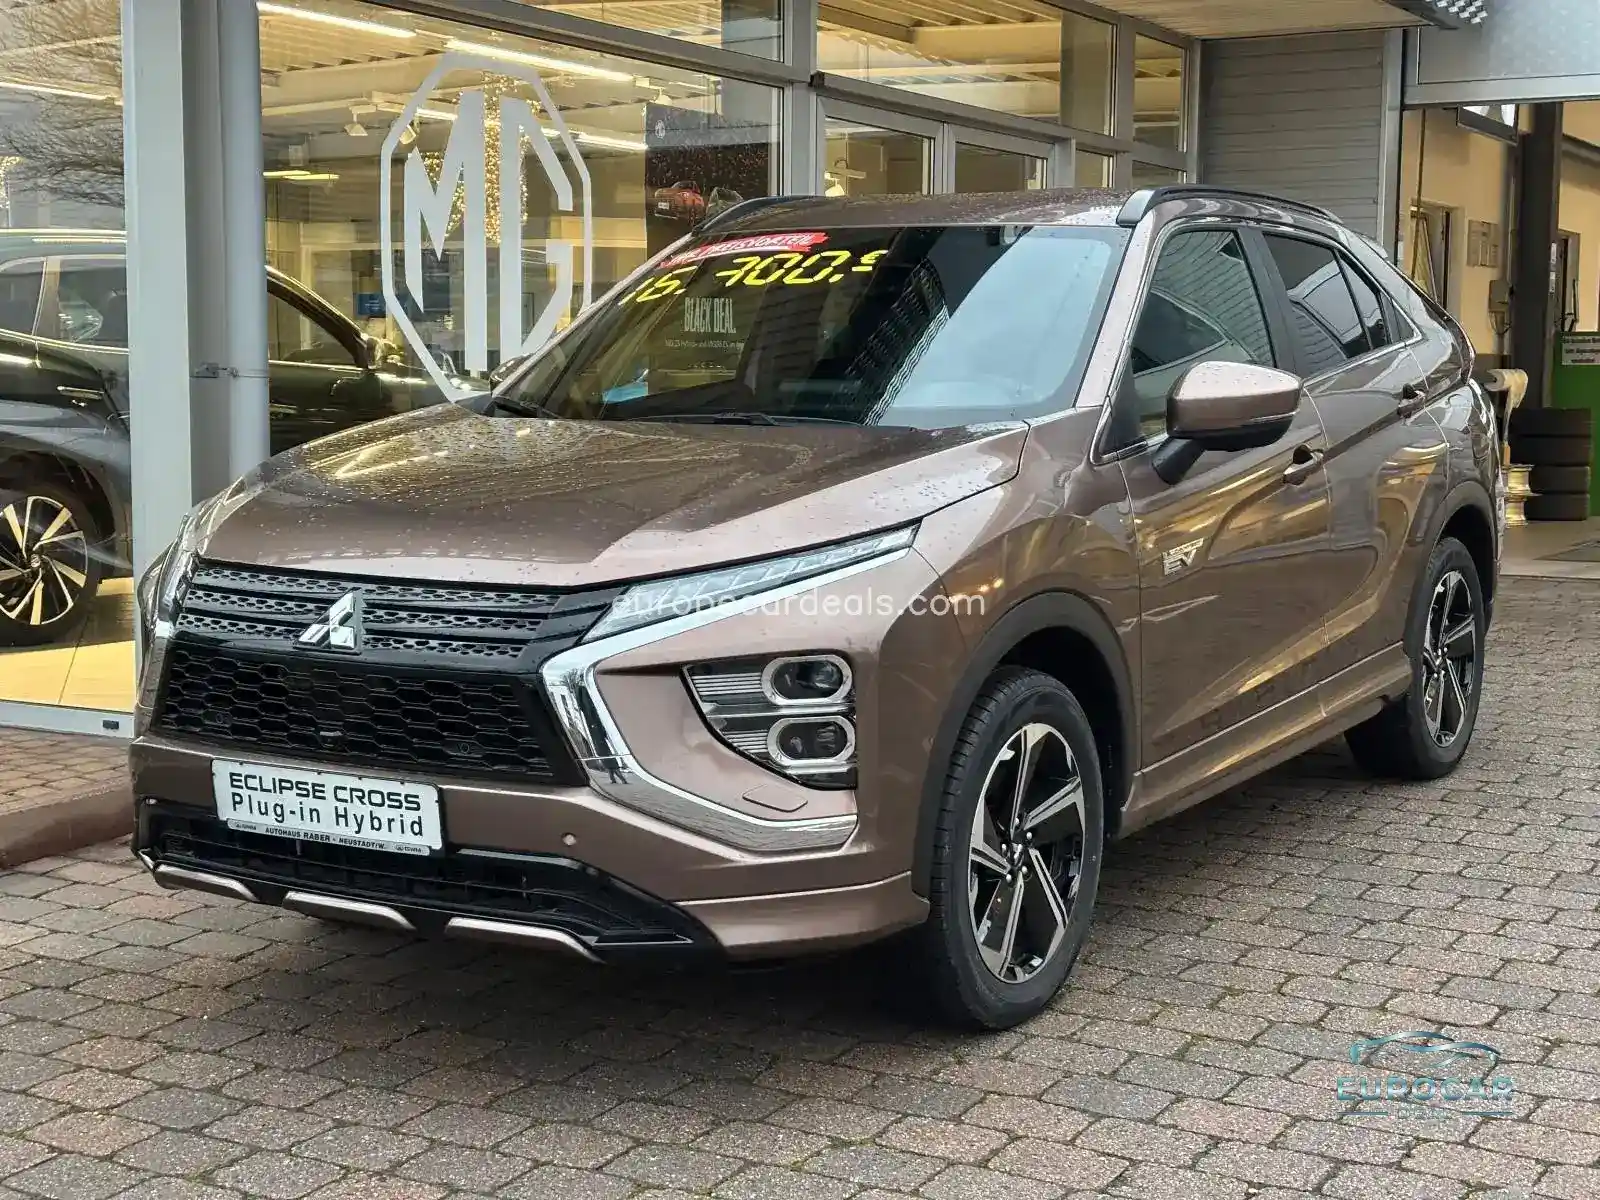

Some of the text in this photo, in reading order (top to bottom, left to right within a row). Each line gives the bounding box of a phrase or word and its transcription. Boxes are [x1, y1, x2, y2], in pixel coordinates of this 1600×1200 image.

[404, 90, 573, 372] MG
[684, 297, 711, 333] BLACK
[229, 772, 421, 811] ECLIPSE CROSS
[231, 792, 423, 837] Plug-in Hybrid
[265, 827, 300, 838] AUTOHAUS
